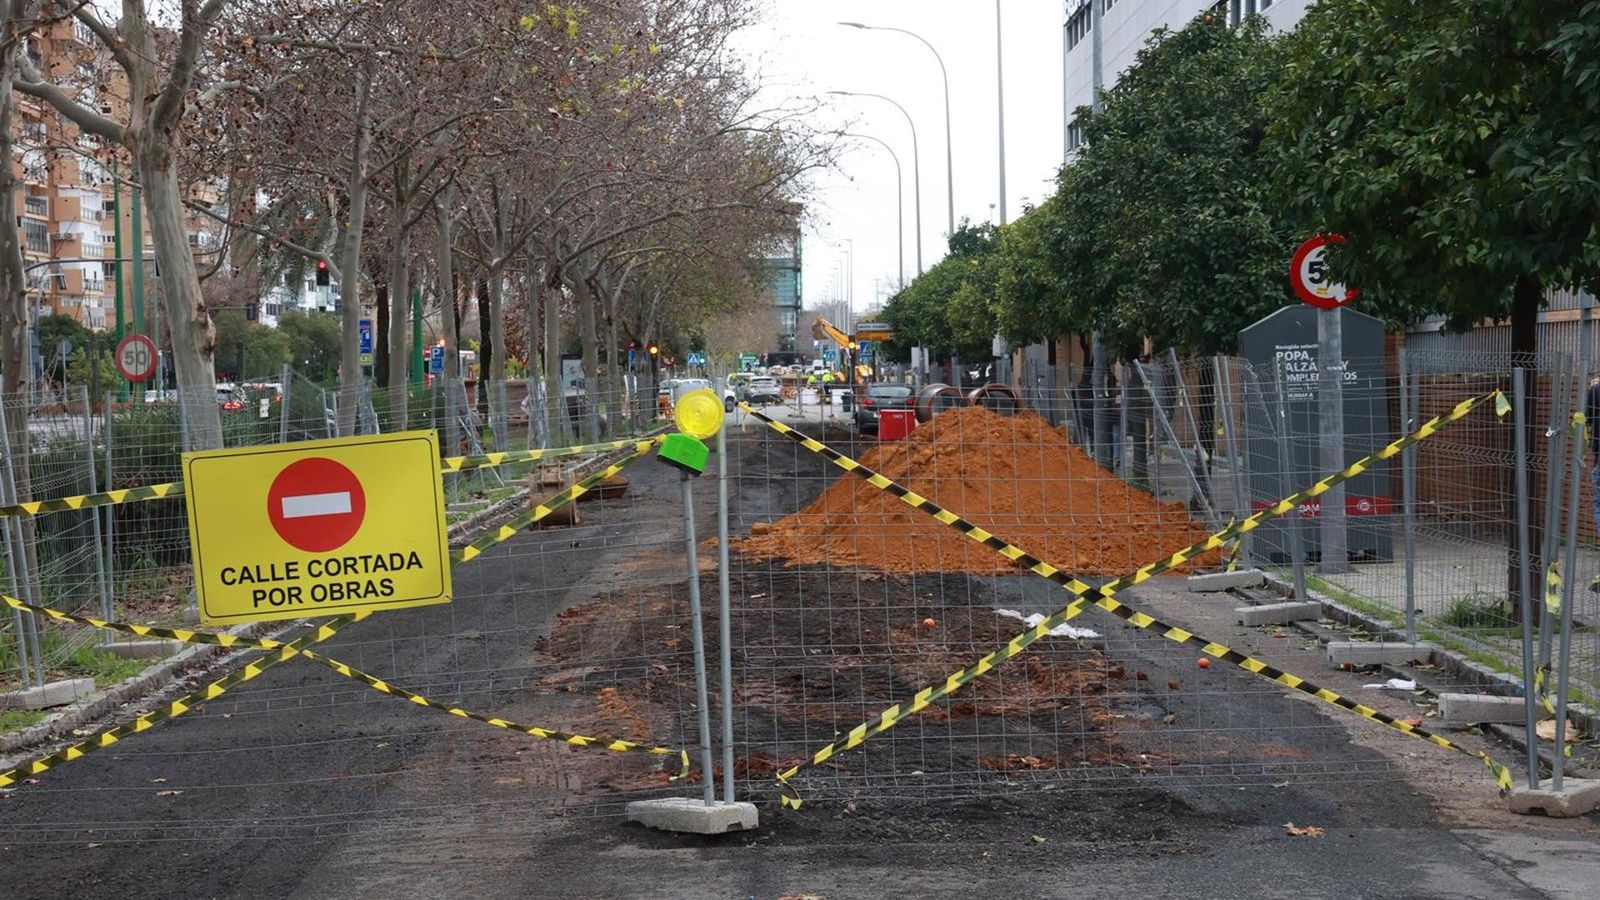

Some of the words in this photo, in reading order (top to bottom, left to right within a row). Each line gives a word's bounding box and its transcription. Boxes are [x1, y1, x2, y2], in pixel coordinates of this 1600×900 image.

[125, 350, 146, 365] 50
[220, 561, 300, 586] CALLE
[307, 551, 423, 578] CORTADA
[252, 586, 304, 608] POR
[310, 578, 395, 602] OBRAS
